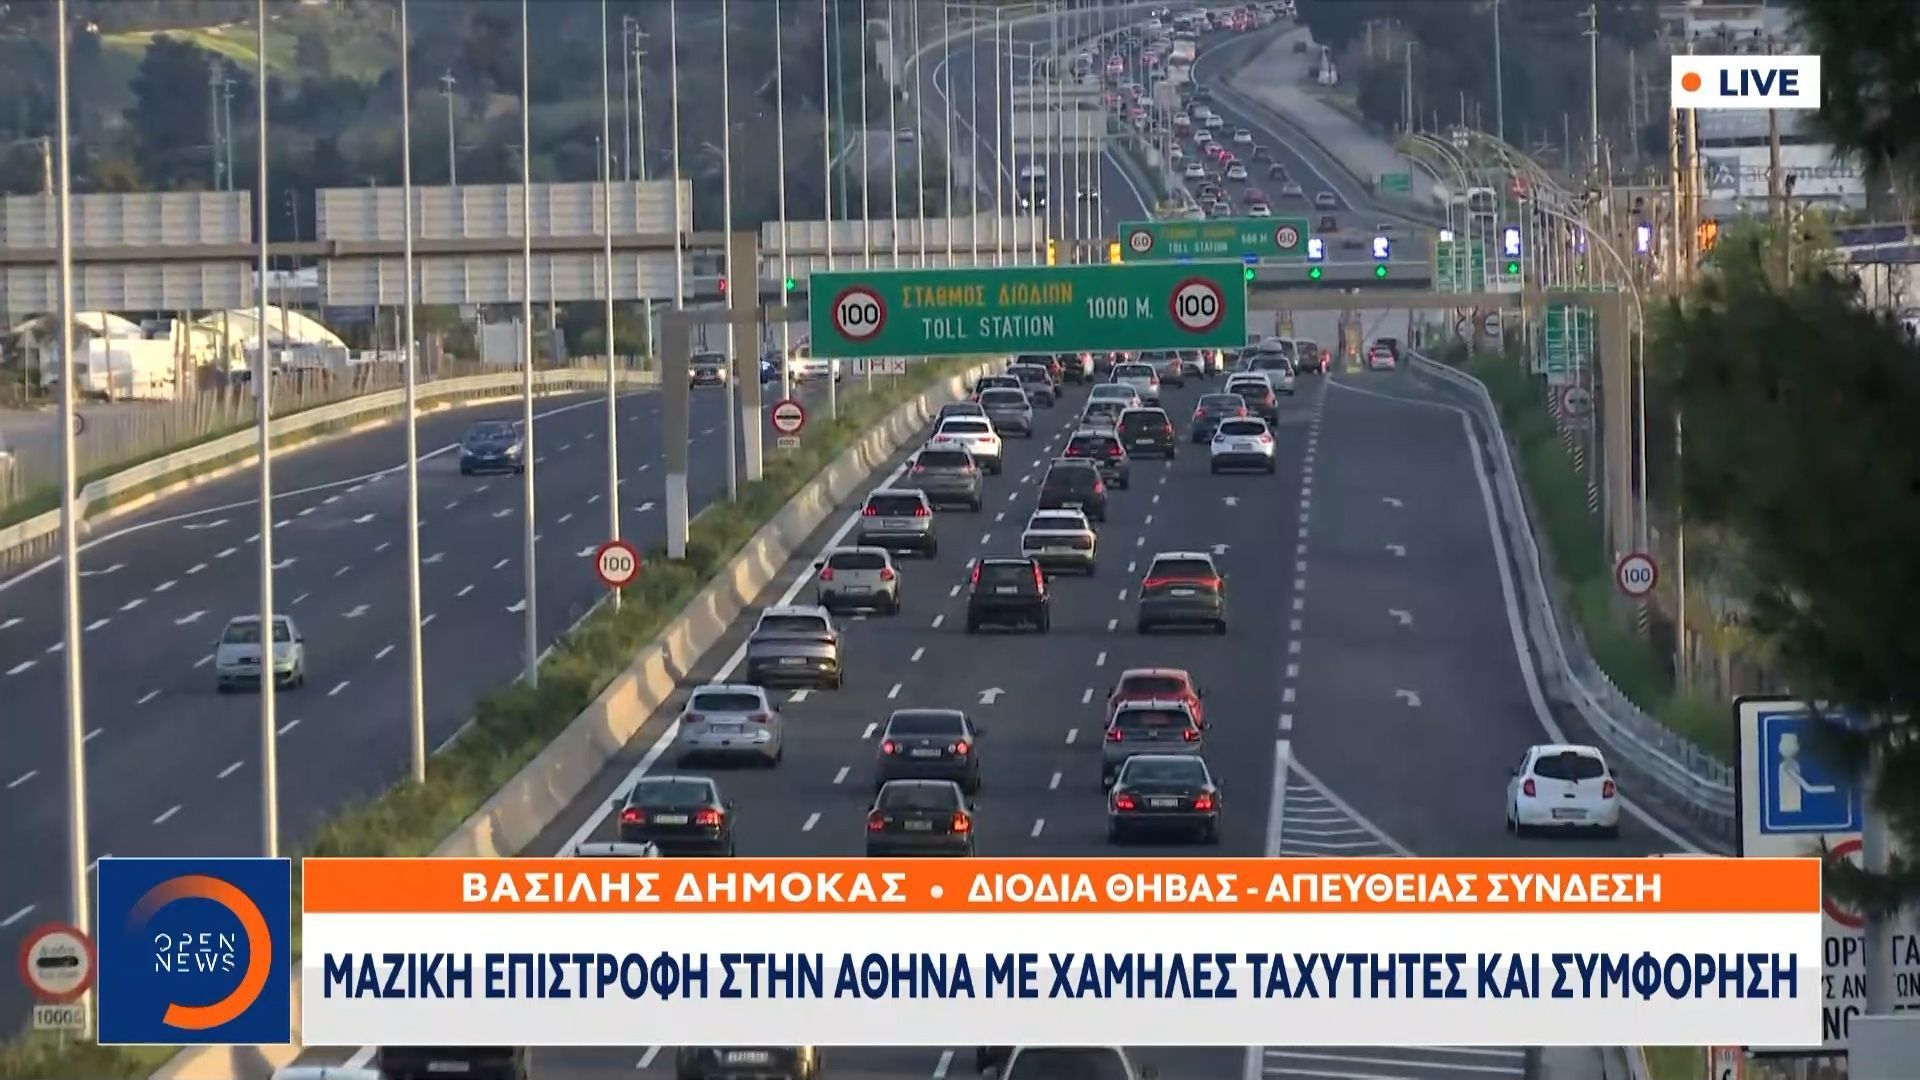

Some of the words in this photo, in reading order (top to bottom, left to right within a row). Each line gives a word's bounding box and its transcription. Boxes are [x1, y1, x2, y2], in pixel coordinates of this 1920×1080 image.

[1134, 236, 1149, 248] 60
[1280, 232, 1294, 244] 60
[902, 285, 985, 309] ΣΤΑΘΜΟΣ
[1178, 294, 1216, 317] 100
[840, 303, 879, 327] 100
[1087, 297, 1129, 319] 1000
[1136, 296, 1154, 319] M.
[922, 317, 967, 340] TOLL
[980, 315, 1055, 339] STATION
[603, 555, 631, 571] 100
[1624, 568, 1651, 583] 100
[37, 1009, 73, 1024] 1000
